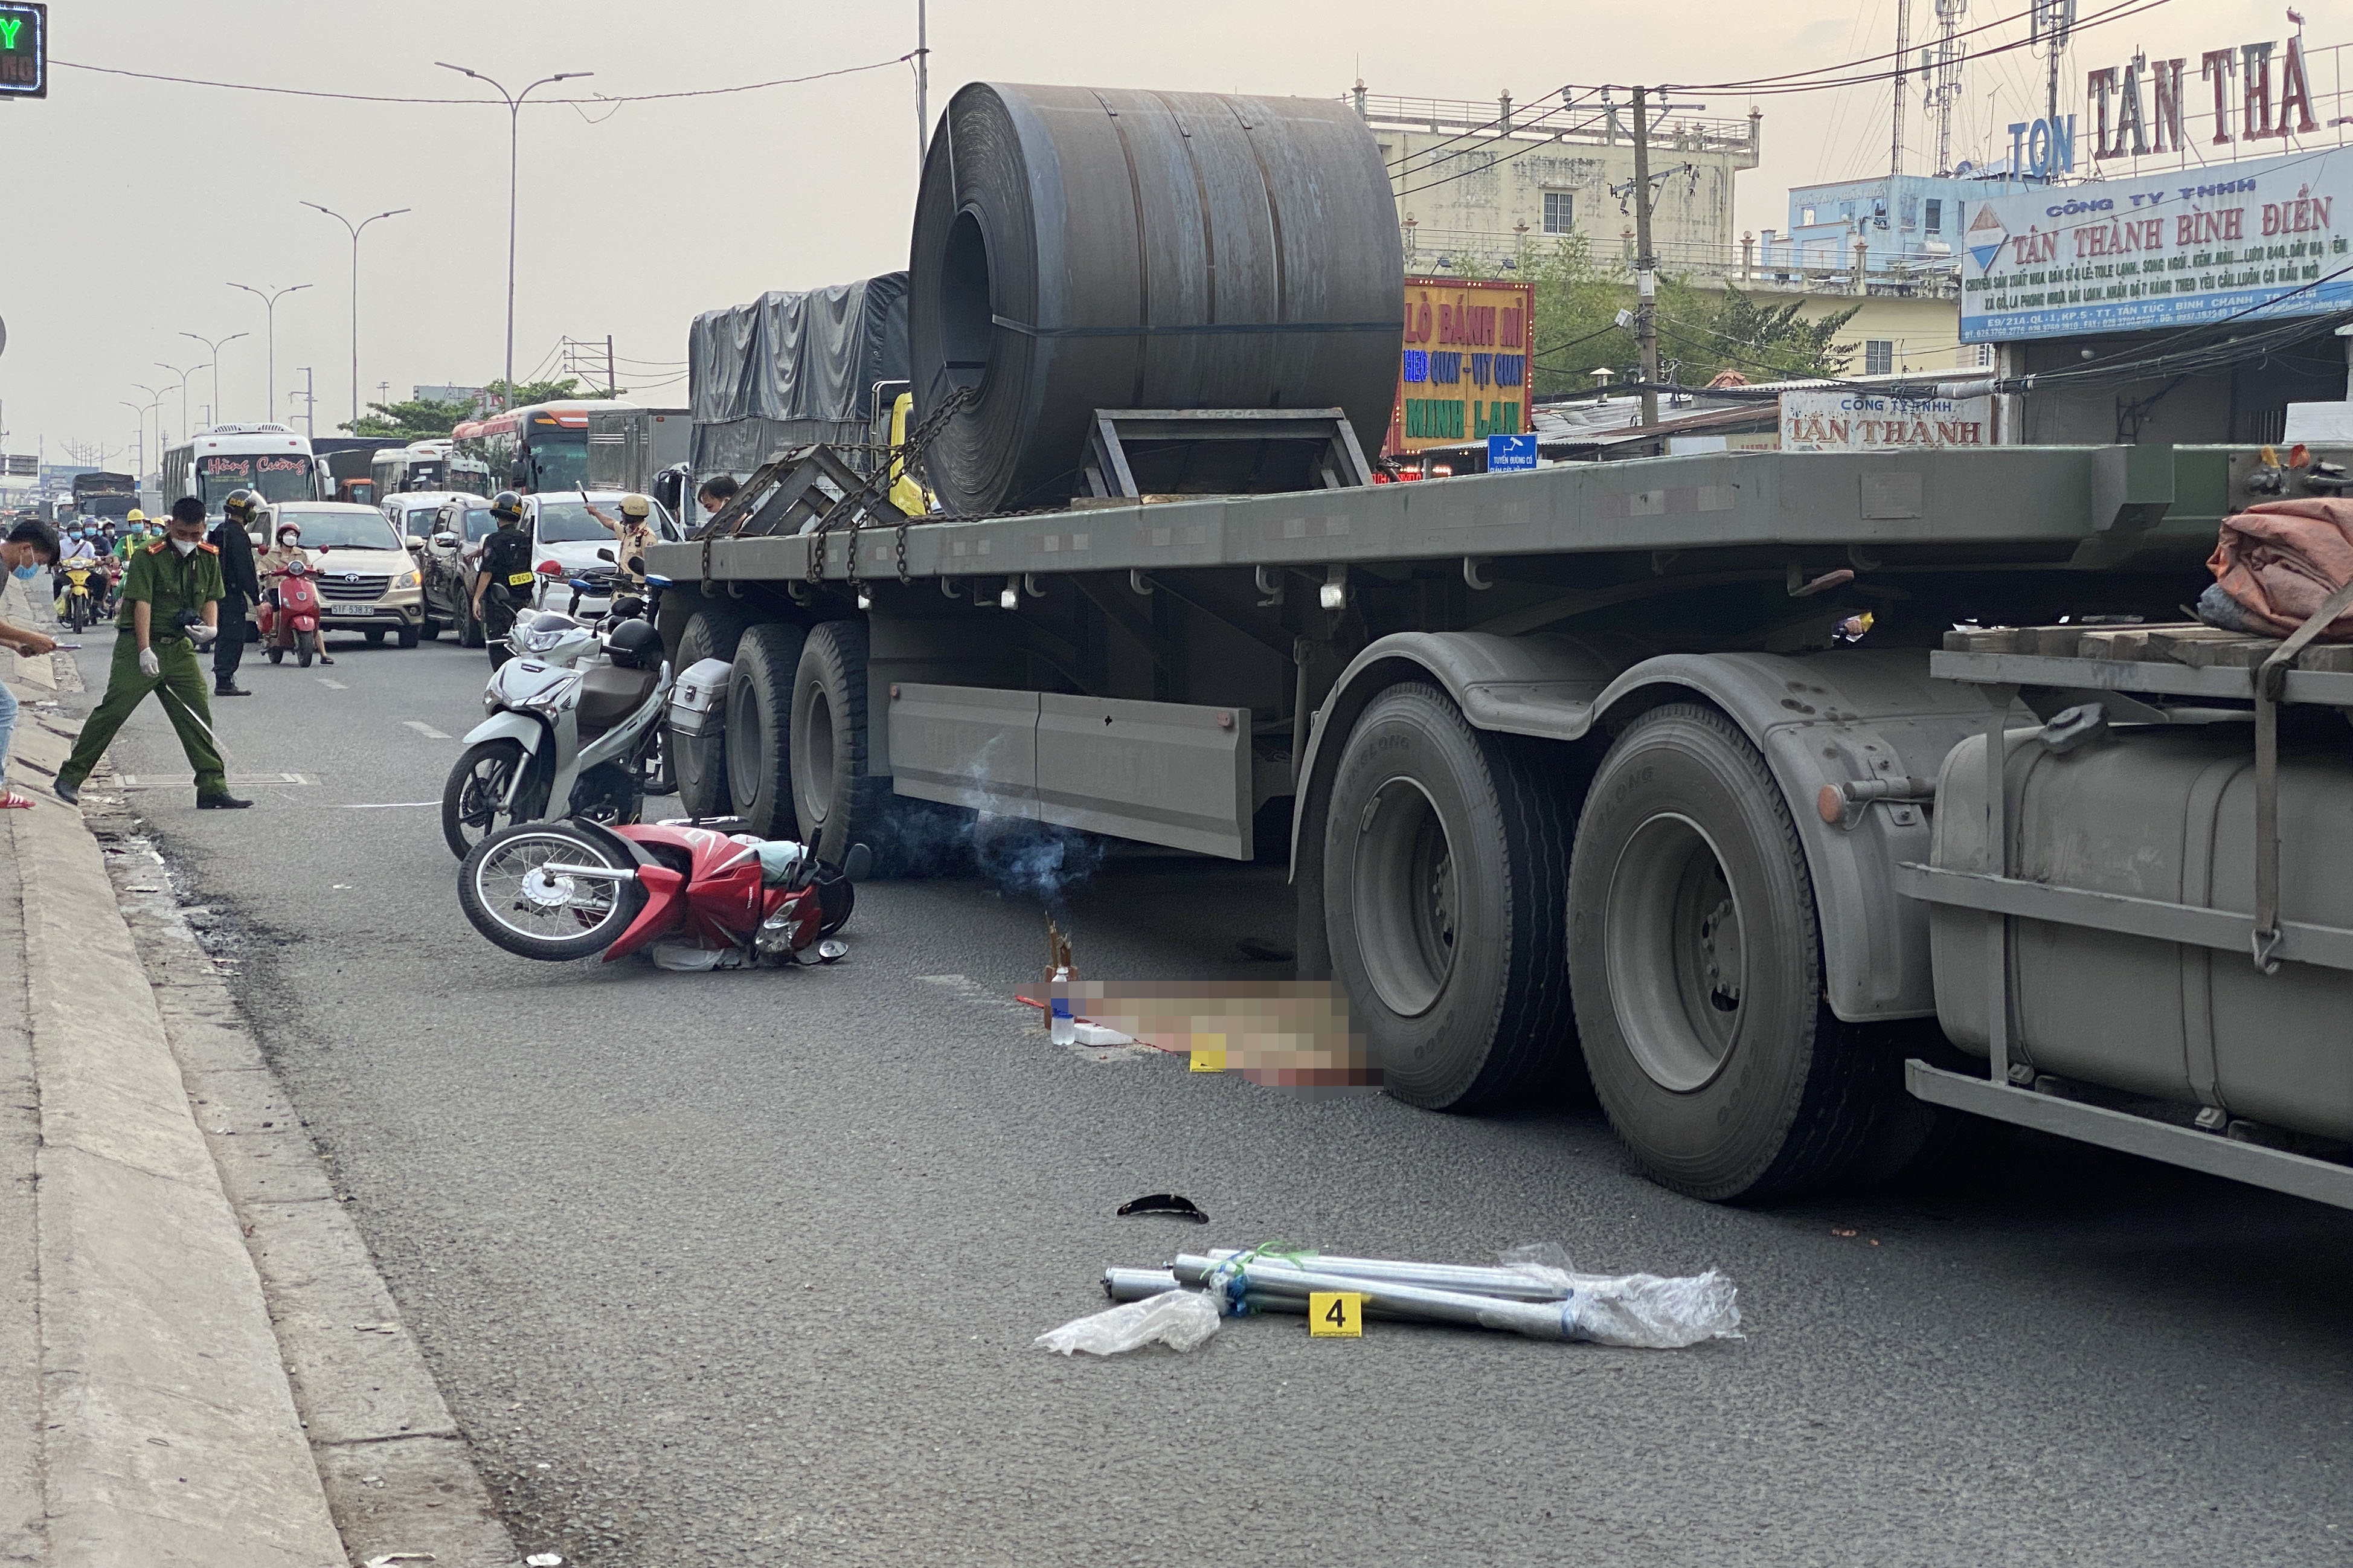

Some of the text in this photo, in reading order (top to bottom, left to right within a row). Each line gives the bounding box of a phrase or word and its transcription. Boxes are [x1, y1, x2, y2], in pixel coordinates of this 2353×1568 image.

[2046, 179, 2256, 217] CÔNG TY TNHH
[2012, 224, 2059, 265] TÂN
[2073, 214, 2165, 258] THÀNH
[2175, 204, 2244, 246] BÌNH
[2030, 271, 2046, 285] MUA
[2095, 264, 2114, 278] TOLE
[2009, 295, 2018, 309] LA
[2175, 277, 2197, 292] THEO
[2116, 304, 2137, 316] TÂN
[2175, 298, 2204, 310] BÌNH
[1405, 291, 1524, 347] LÒ BÁNH MÌ
[1404, 350, 1429, 382] HEO
[1431, 350, 1462, 386] QUAY
[1472, 353, 1493, 391] VỊT
[1494, 353, 1526, 388] QUAY
[1406, 398, 1520, 439] MINH LAN
[1841, 396, 1884, 412] CÔNG
[1786, 413, 1982, 445] TÂN THÀNH
[208, 456, 306, 476] Hùng Cường
[1494, 454, 1508, 464] TUYẾN
[1526, 454, 1533, 464] CÓ
[1326, 1299, 1346, 1328] 4
